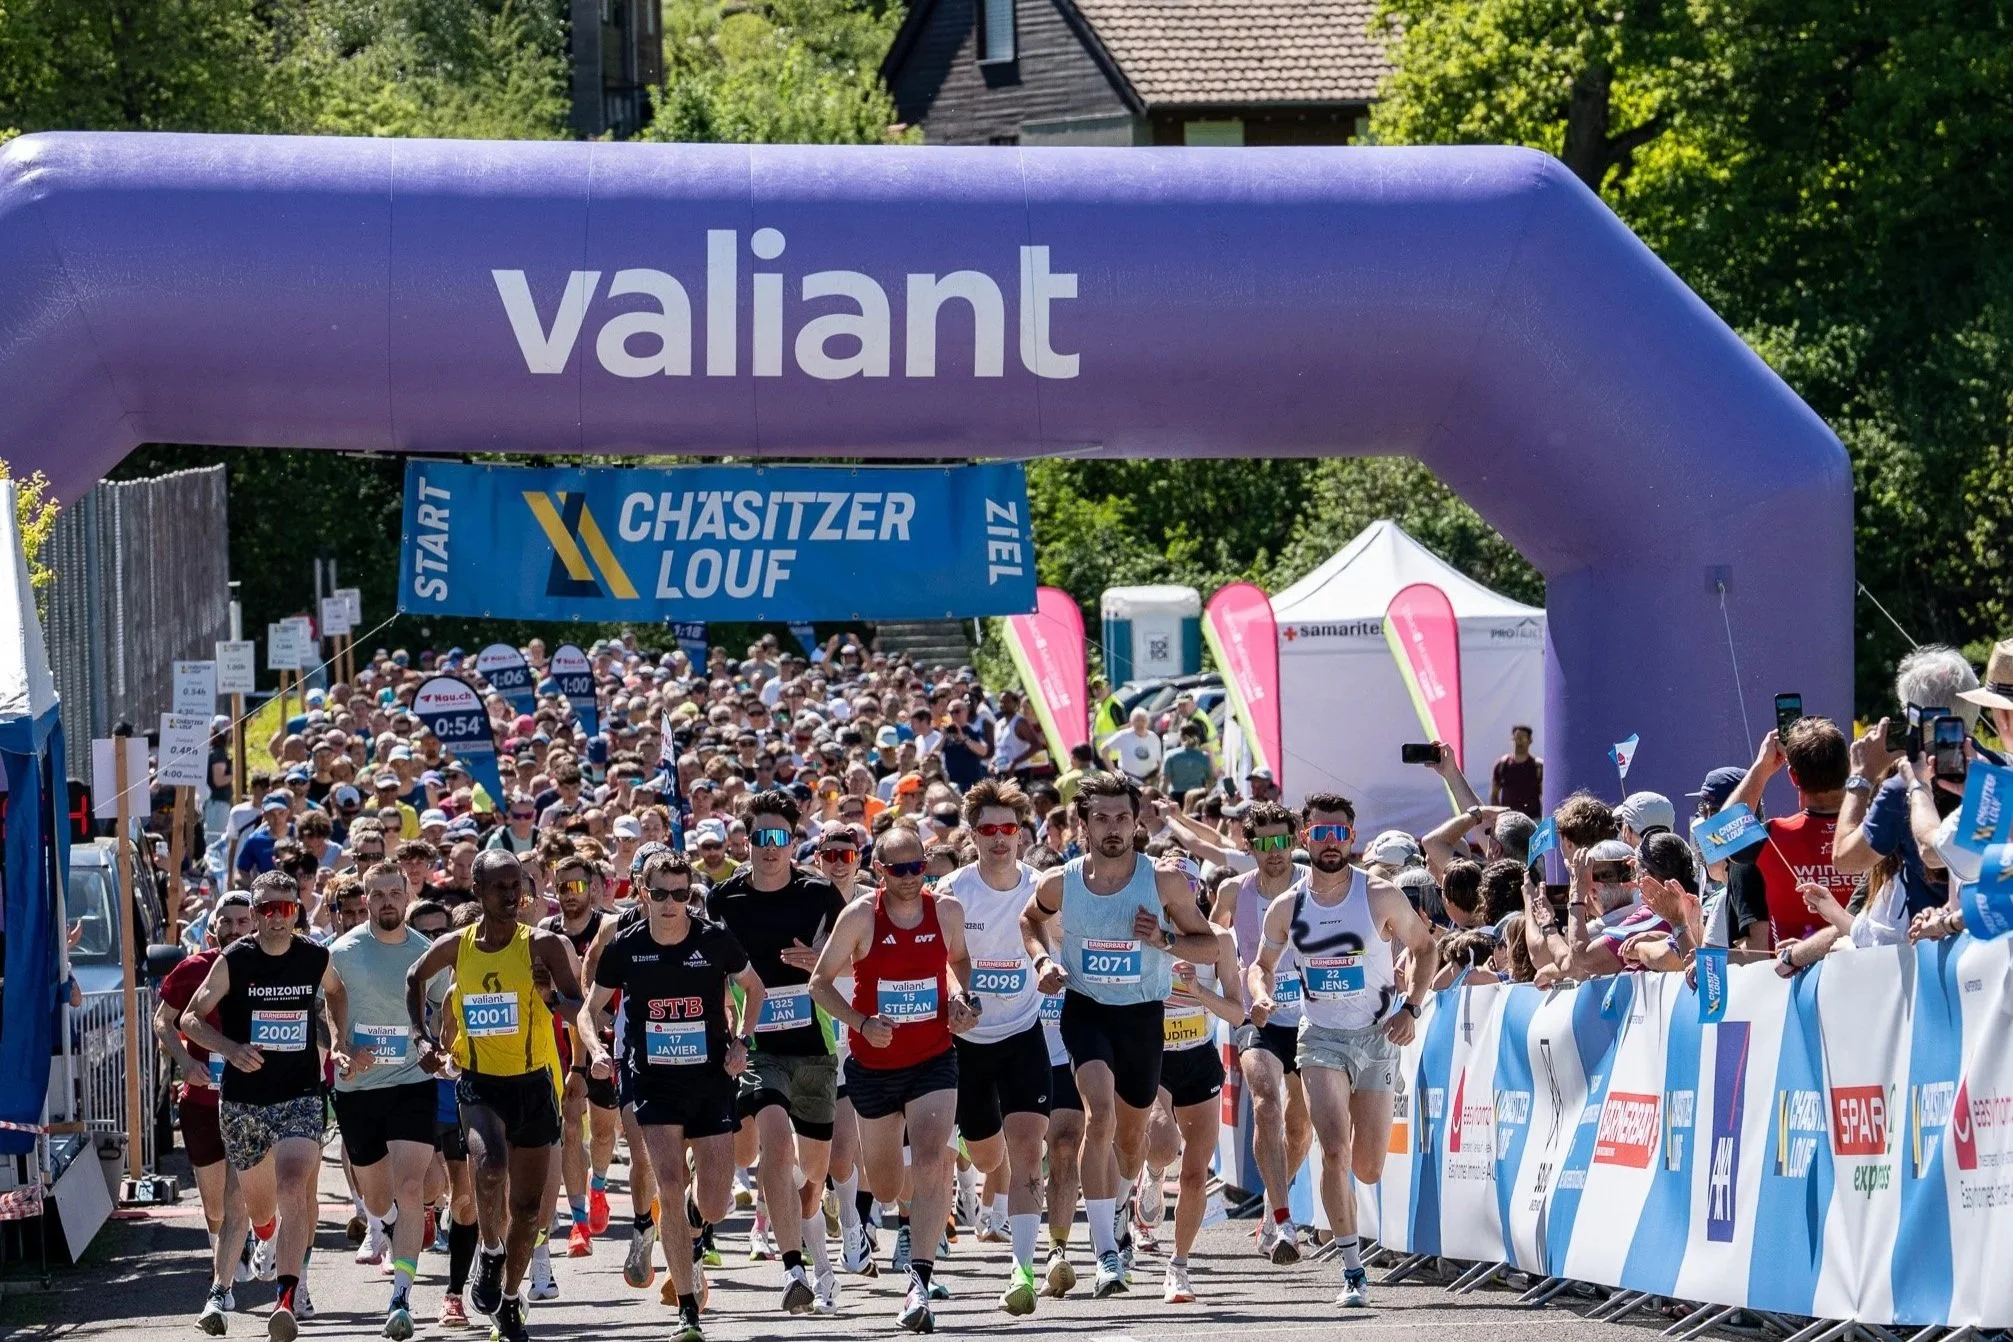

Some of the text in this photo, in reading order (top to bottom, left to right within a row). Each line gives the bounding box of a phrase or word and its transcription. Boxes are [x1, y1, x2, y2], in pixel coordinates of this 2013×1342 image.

[491, 228, 1080, 380] valiant
[618, 491, 916, 541] CHÄSITZER
[414, 477, 450, 601] START
[985, 498, 1023, 586] ZIEL
[656, 549, 797, 600] LOUF
[1300, 620, 1384, 637] samarite
[490, 670, 525, 687] 1:06
[562, 676, 590, 693] 1:00
[434, 692, 472, 702] Nau.ch
[434, 716, 480, 737] 0:54
[1088, 955, 1131, 971] 2071
[1326, 970, 1339, 978] 22
[892, 982, 926, 991] valiant
[975, 974, 1020, 989] 2098
[1320, 980, 1350, 991] JENS
[248, 985, 313, 997] HORIZONTE
[902, 993, 915, 1001] 15
[1272, 991, 1300, 1000] BRIEL
[472, 995, 504, 1004] valiant
[769, 998, 794, 1009] 1325
[1046, 1000, 1057, 1008] 21
[648, 997, 704, 1019] STB
[884, 1001, 931, 1014] STEFAN
[468, 1008, 509, 1025] 2001
[770, 1009, 795, 1021] JAN
[258, 1026, 300, 1040] 2002
[367, 1027, 396, 1035] valiant
[1164, 1028, 1198, 1041] UDITH
[376, 1037, 387, 1045] 18
[669, 1035, 681, 1044] 17
[656, 1045, 697, 1055] JAVIER
[1839, 1097, 1886, 1144] SPAR
